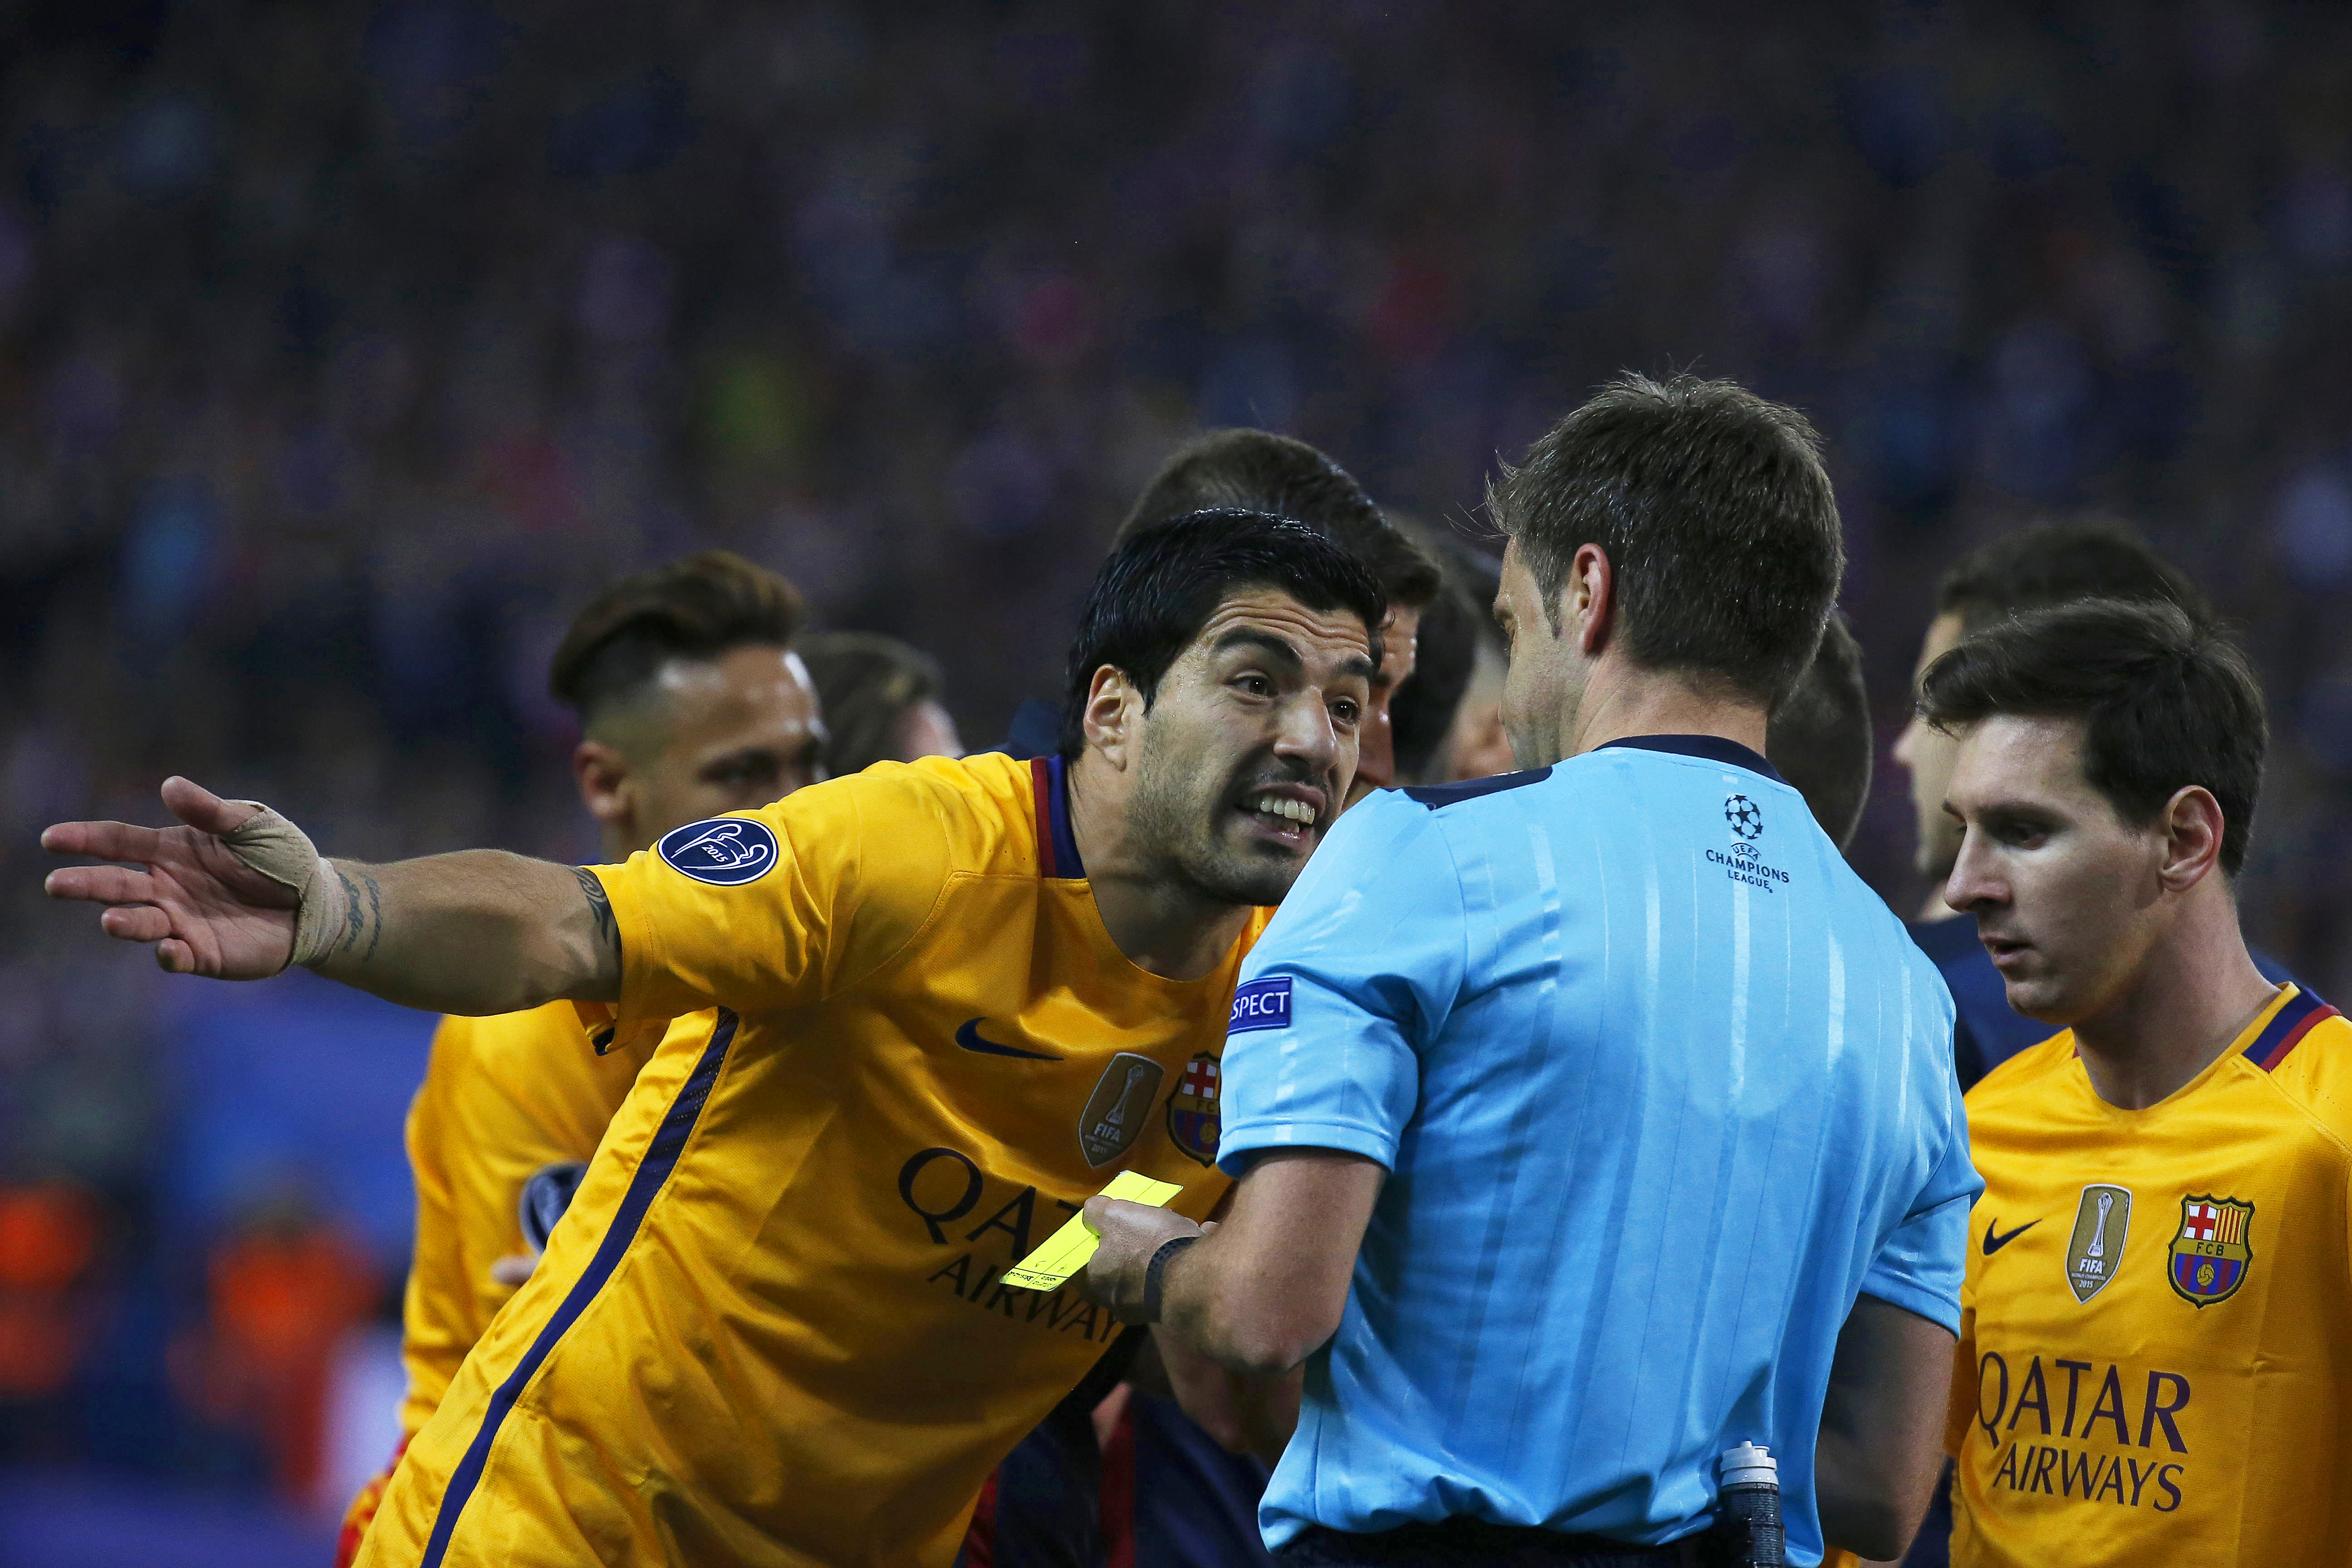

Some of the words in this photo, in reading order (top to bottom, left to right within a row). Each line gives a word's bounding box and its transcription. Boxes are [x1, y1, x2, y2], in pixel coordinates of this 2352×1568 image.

[701, 844, 728, 862] 2015
[1732, 845, 1759, 860] UEFA
[1705, 849, 1789, 883] CHAMPIONS
[1727, 870, 1769, 889] LEAGUE
[1094, 1122, 1120, 1142] FIFA
[2196, 1241, 2225, 1256] FCB
[2079, 1258, 2103, 1274] FIFA
[2079, 1279, 2093, 1288] 2015
[1979, 1351, 2191, 1454] QATAR
[1992, 1442, 2185, 1512] AIRWAYS
